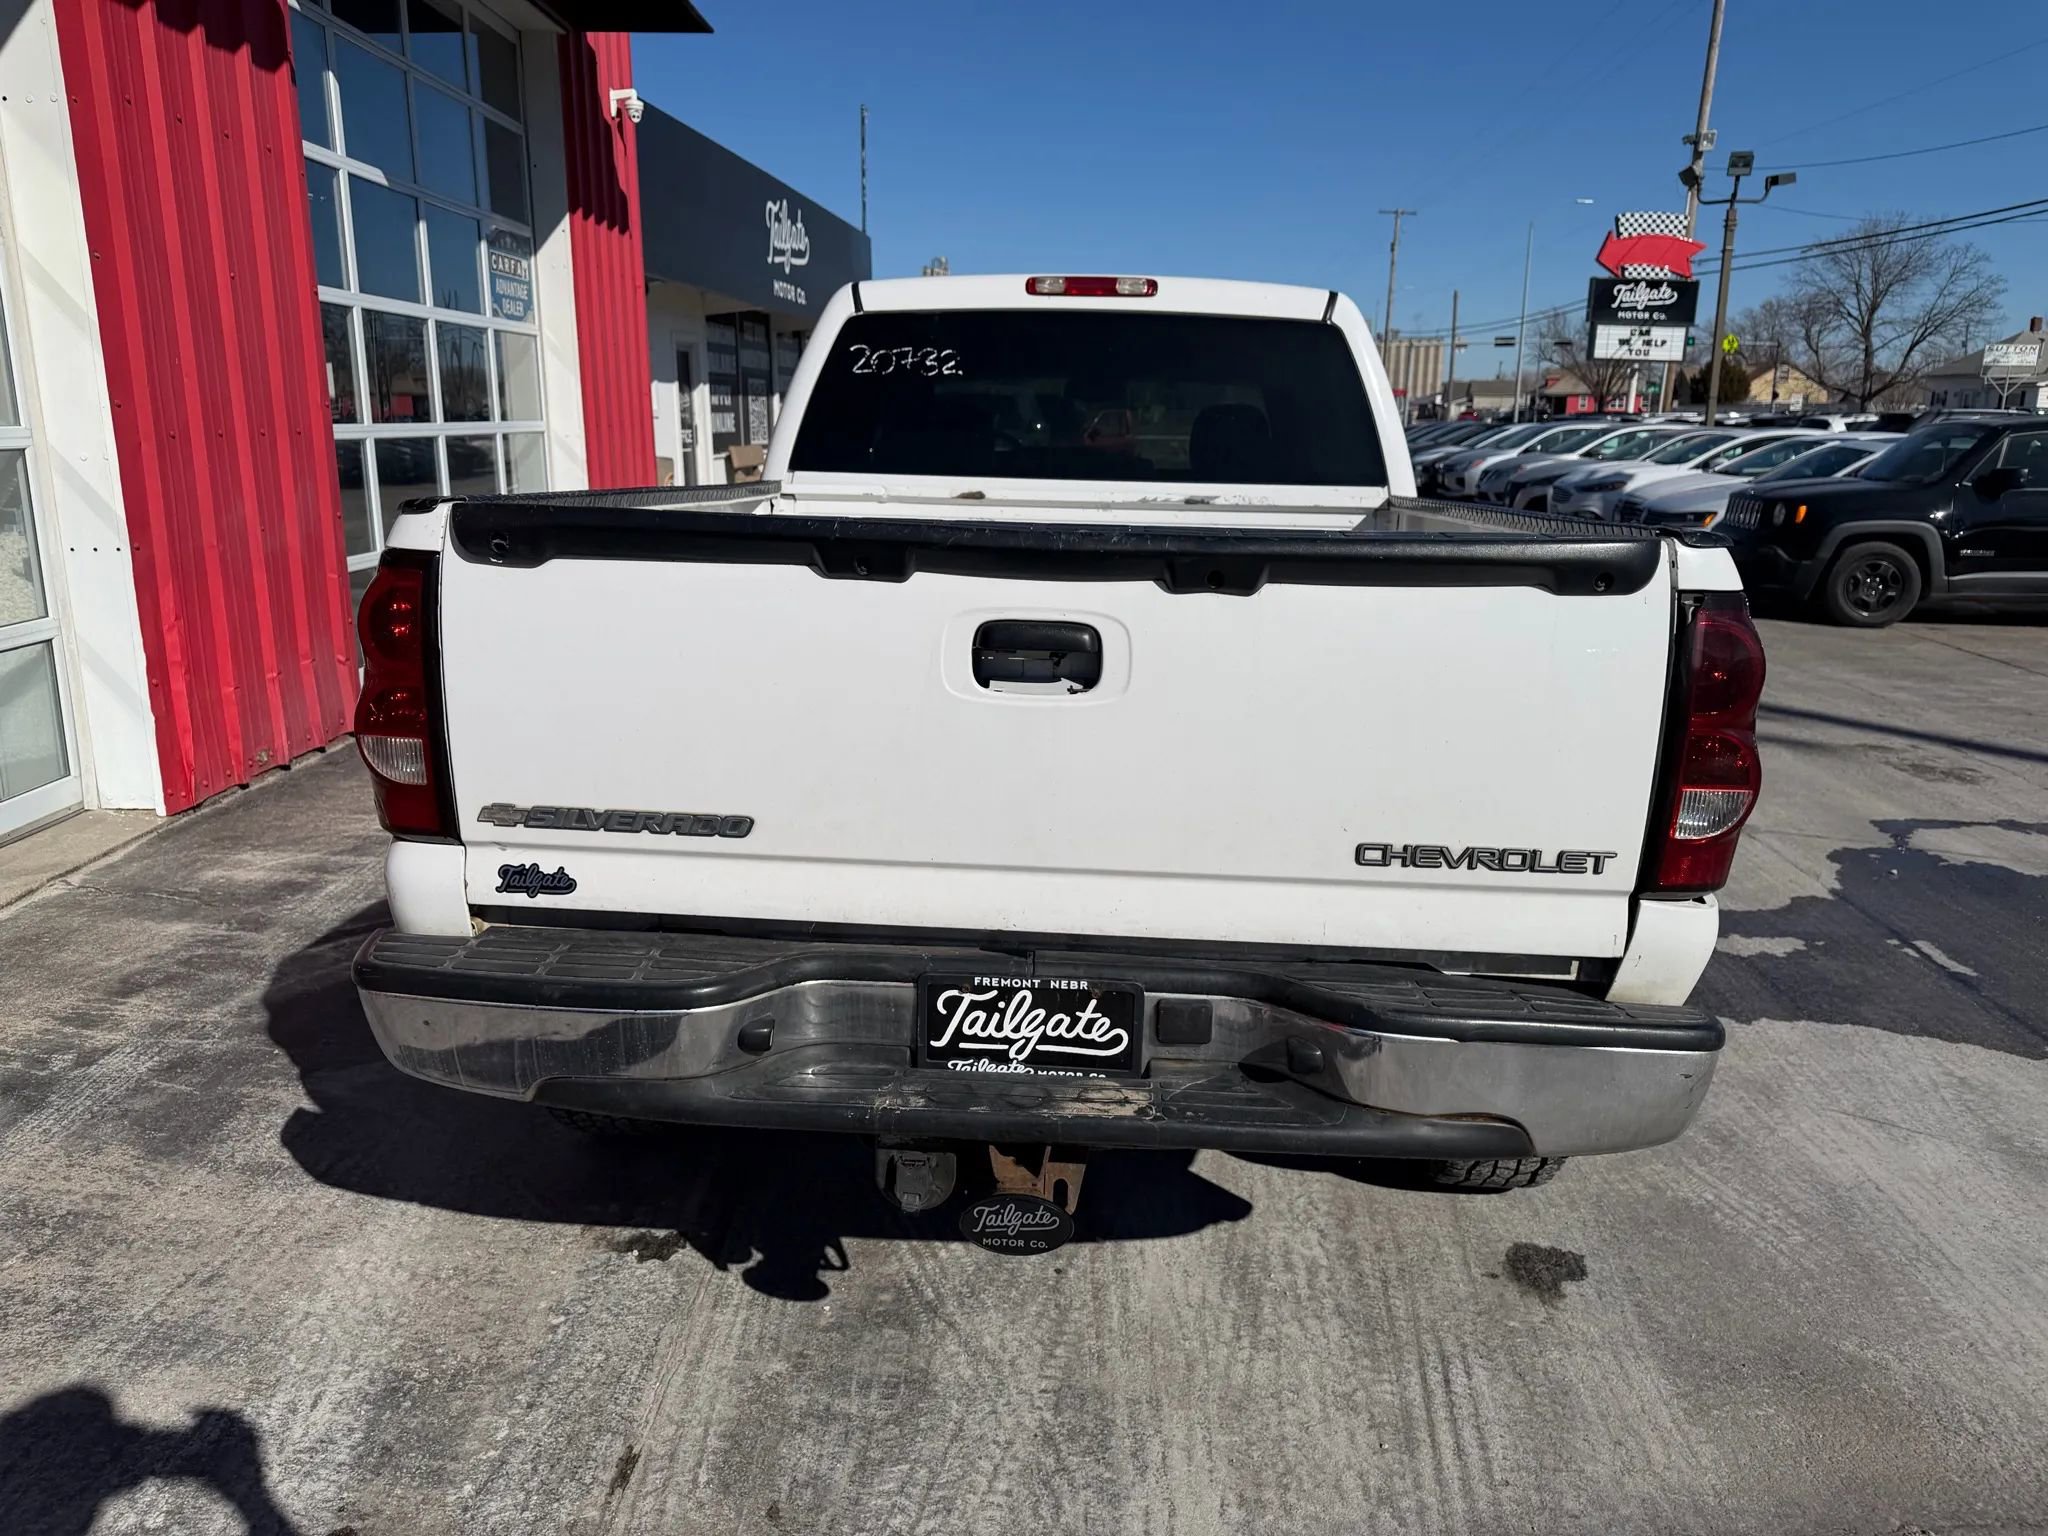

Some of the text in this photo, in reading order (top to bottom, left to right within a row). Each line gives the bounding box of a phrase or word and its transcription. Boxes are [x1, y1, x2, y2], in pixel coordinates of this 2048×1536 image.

[765, 199, 810, 274] Tailgate
[491, 254, 529, 279] CARFAX
[496, 279, 528, 300] ADVANTAGE
[1611, 281, 1678, 310] Tailgate
[502, 298, 525, 317] DEALER
[1617, 310, 1650, 320] MOTOR
[1618, 338, 1667, 347] WE HELP
[1630, 328, 1651, 336] CAN
[524, 806, 755, 838] SILVERADO
[1355, 843, 1617, 875] CHEVROLET
[495, 863, 577, 898] Tailgate
[974, 976, 1088, 990] FREMONT NEBR
[930, 989, 1129, 1061] Tailgate
[972, 1203, 1060, 1235] Tailgate
[982, 1237, 1025, 1248] MOTOR
